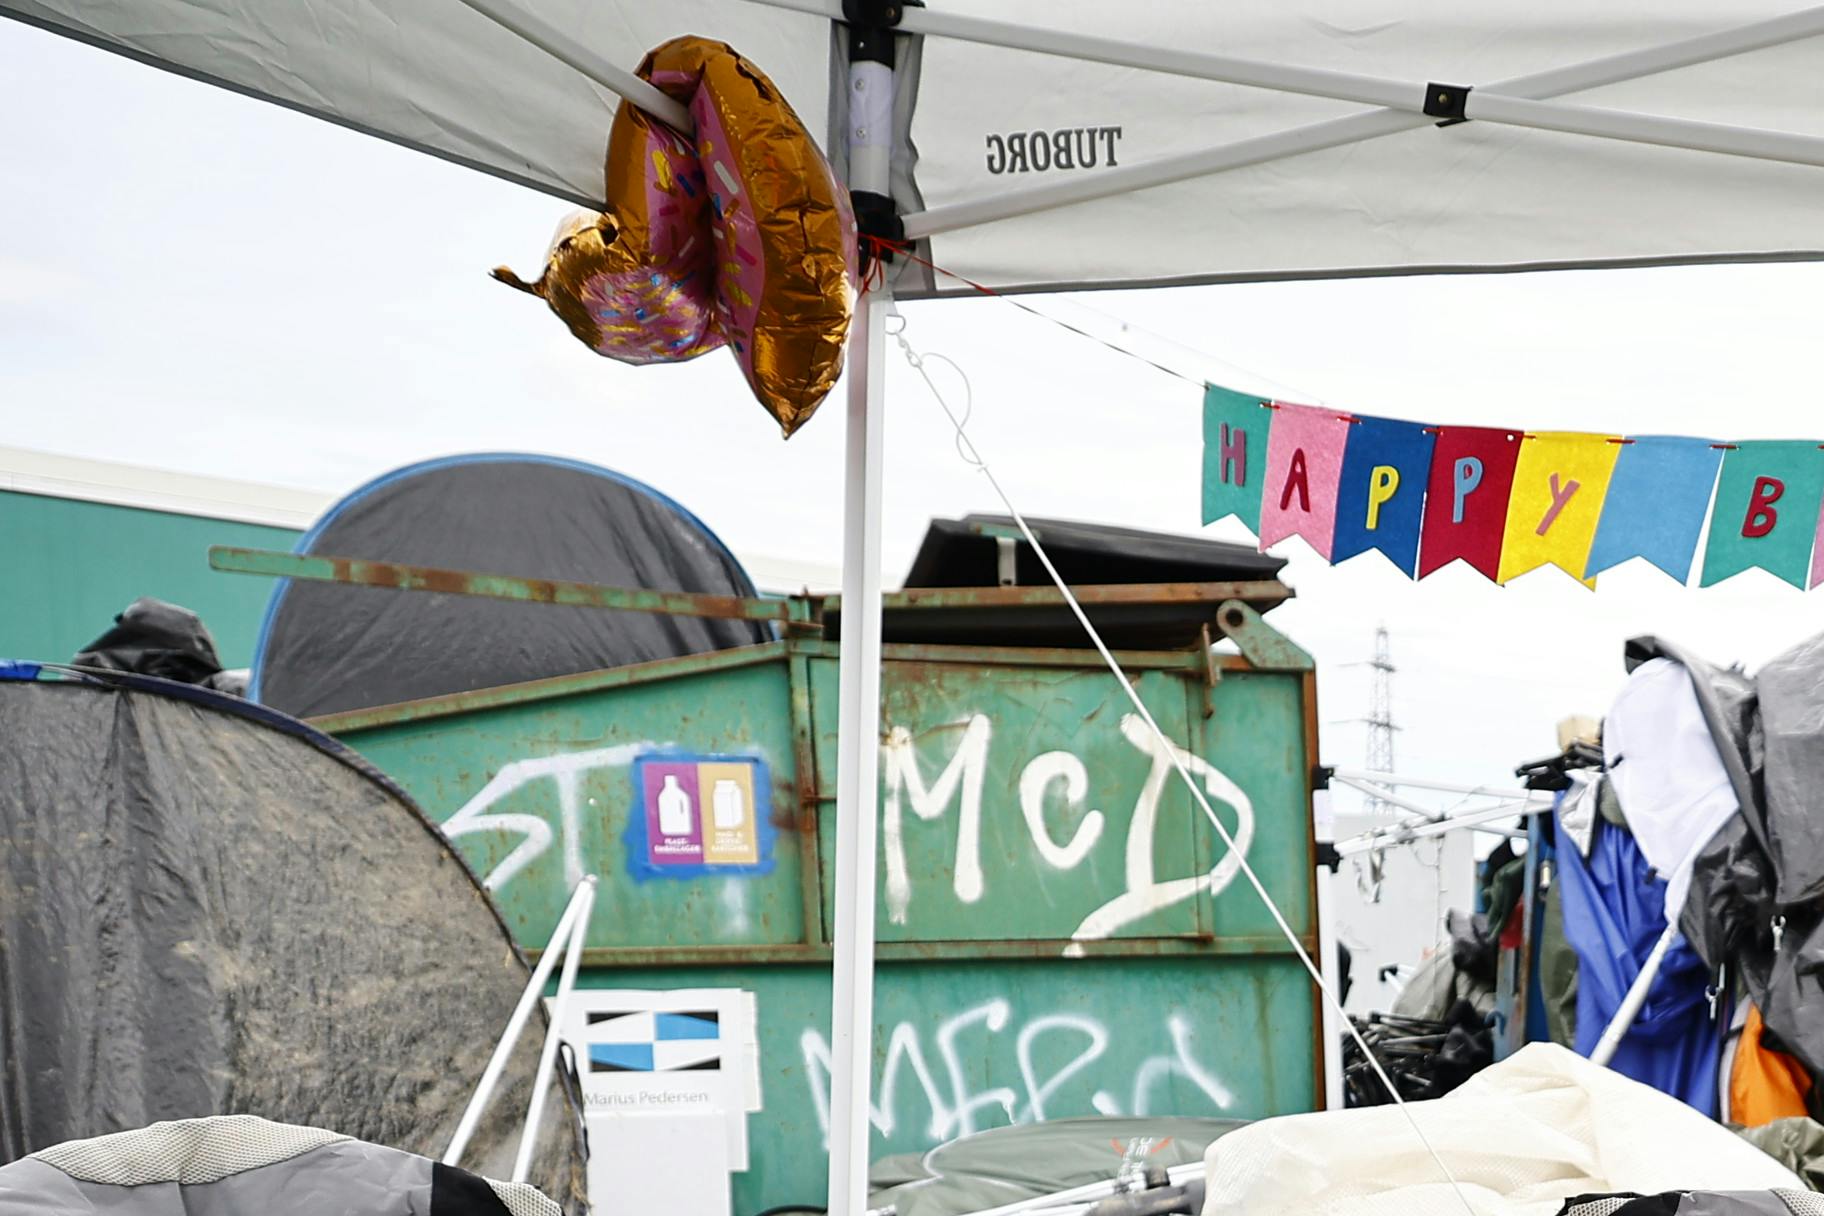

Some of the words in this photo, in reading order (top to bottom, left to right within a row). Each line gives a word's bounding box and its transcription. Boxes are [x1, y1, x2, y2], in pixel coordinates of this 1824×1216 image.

[1219, 422, 1580, 537] HAPPY
[583, 1091, 635, 1106] Marius
[638, 1089, 709, 1104] Pedersen
